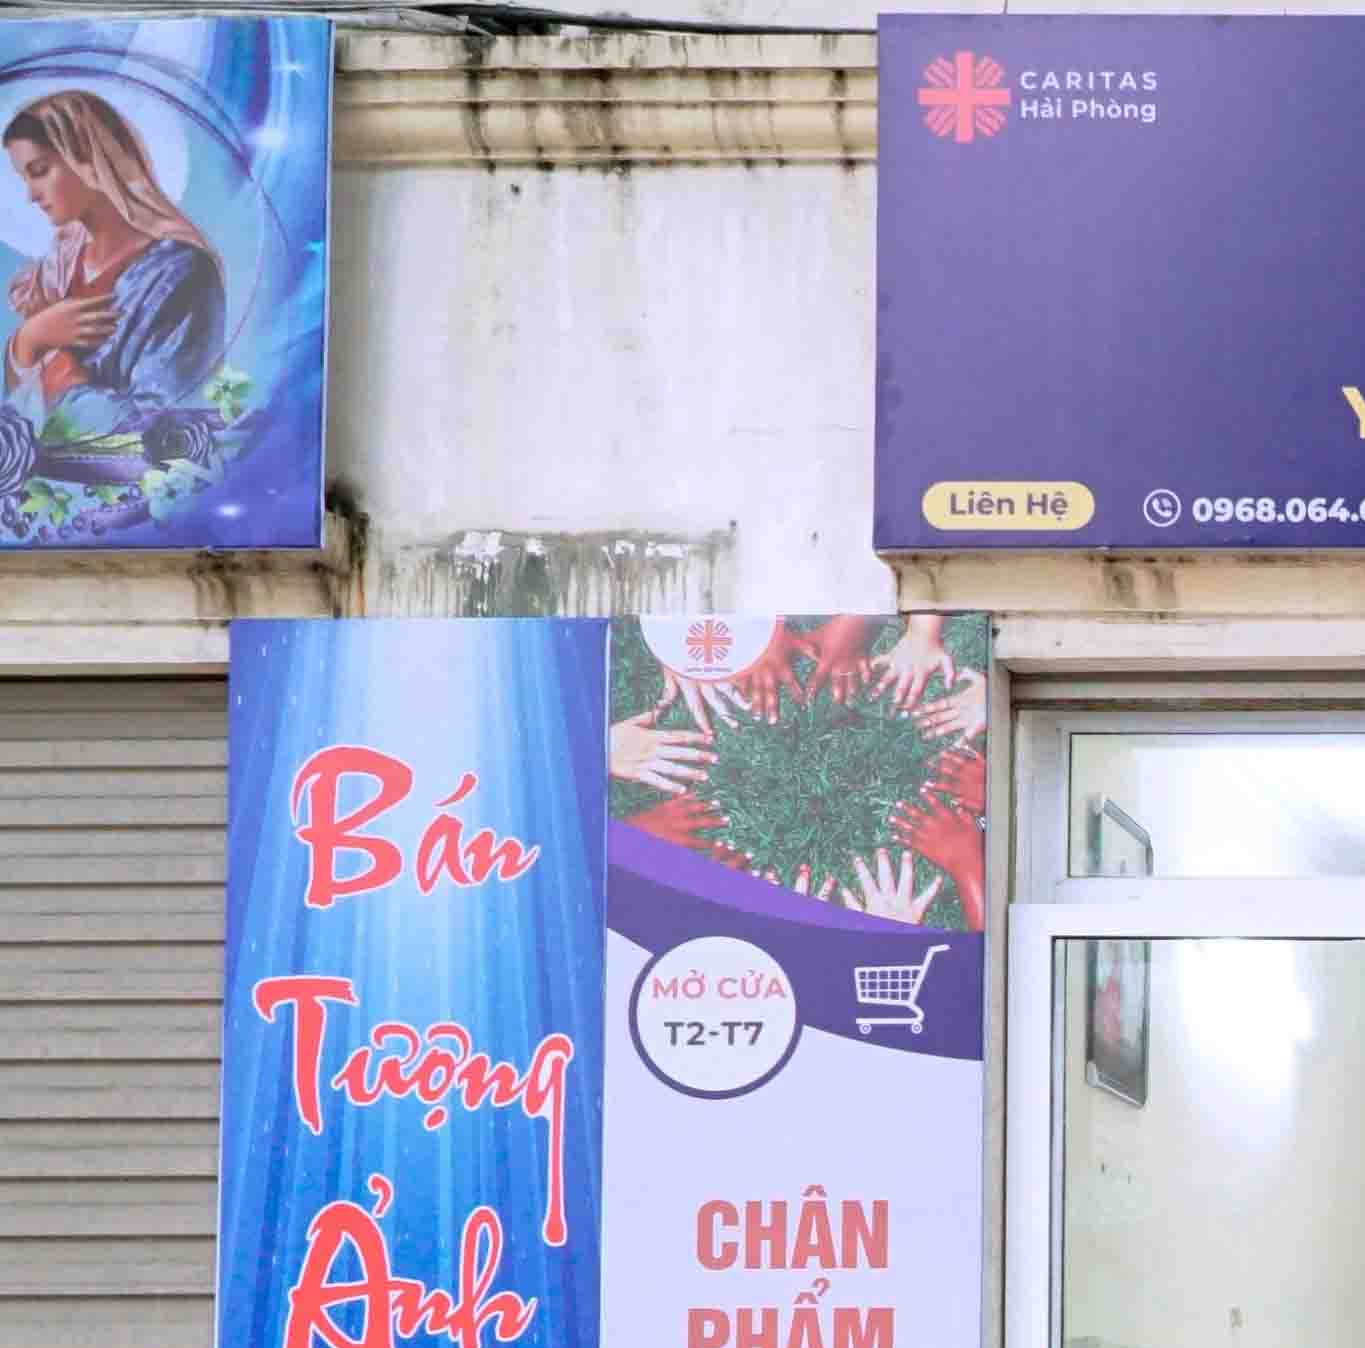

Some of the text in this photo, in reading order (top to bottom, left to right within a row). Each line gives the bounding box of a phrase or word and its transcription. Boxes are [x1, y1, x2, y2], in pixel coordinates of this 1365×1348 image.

[1020, 72, 1157, 90] CARITAS
[1021, 97, 1156, 122] Hải Phòng
[951, 489, 1069, 521] Liên Hệ
[293, 745, 540, 909] Bán
[653, 970, 785, 999] MỞ CỬA
[664, 1021, 763, 1046] T2-T7
[252, 976, 574, 1246] Tượng
[697, 1185, 888, 1270] CHÂN
